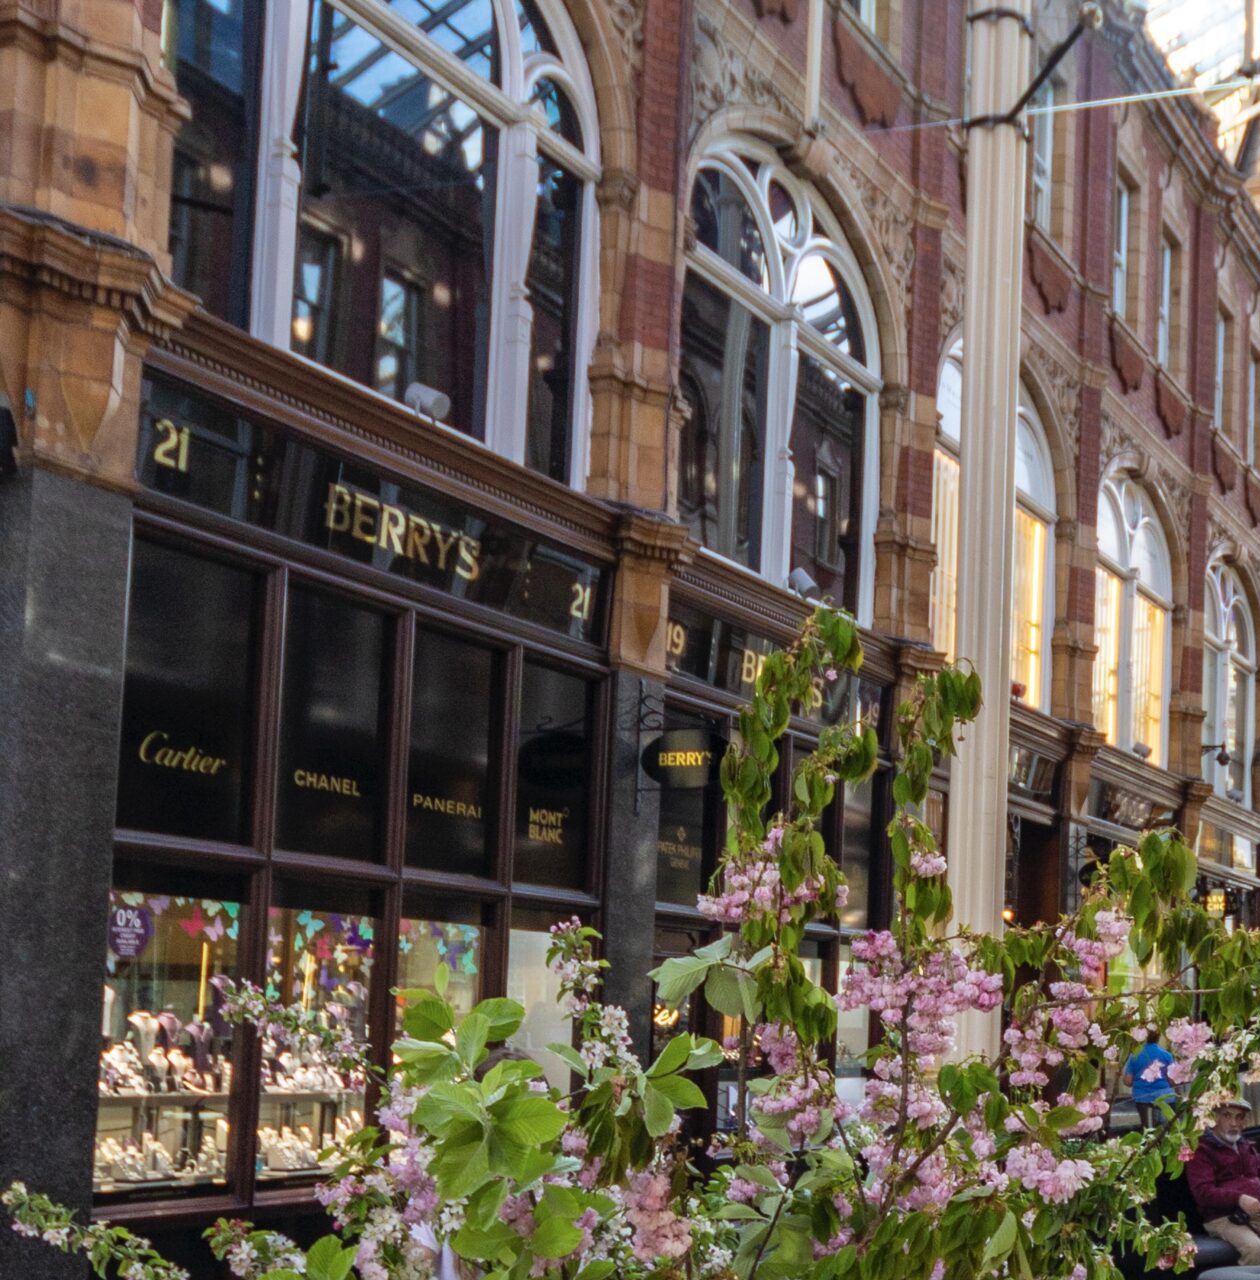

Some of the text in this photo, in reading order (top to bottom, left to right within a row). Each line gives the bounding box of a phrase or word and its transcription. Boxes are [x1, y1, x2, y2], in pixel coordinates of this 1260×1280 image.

[154, 418, 190, 473] 21
[324, 482, 481, 580] BERRY'S
[569, 583, 591, 620] 21
[666, 621, 686, 656] 19
[138, 730, 228, 775] Cartier
[293, 768, 362, 798] CHANEL
[412, 792, 482, 820] PANERAI
[529, 807, 563, 827] MONT
[528, 824, 563, 845] BLANC
[116, 908, 142, 928] 0%
